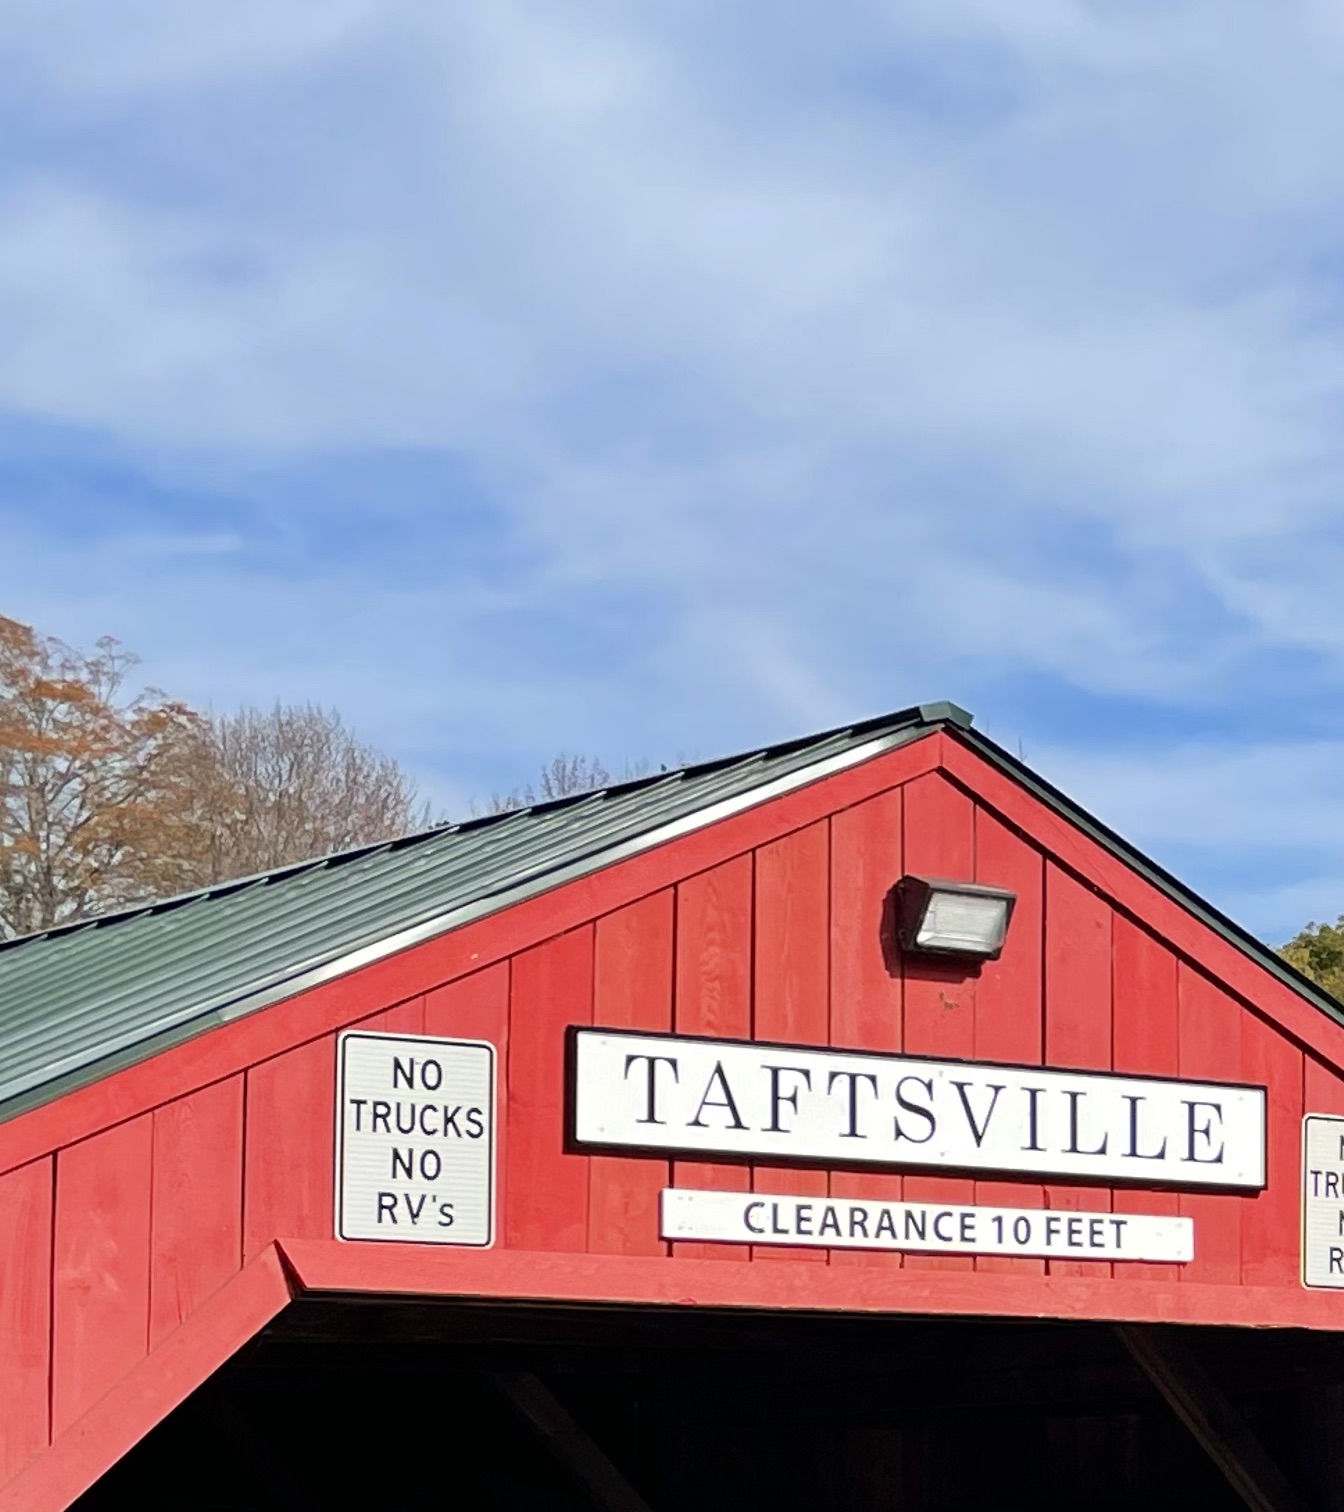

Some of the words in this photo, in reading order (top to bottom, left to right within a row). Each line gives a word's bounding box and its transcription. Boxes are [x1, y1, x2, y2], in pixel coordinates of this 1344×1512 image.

[393, 1056, 442, 1091] NO
[349, 1099, 485, 1139] TRUCKS
[623, 1053, 1225, 1165] TAFTSVILLE
[391, 1147, 442, 1181] NO
[376, 1192, 455, 1227] RV's
[743, 1201, 977, 1243] CLEARANCE
[991, 1215, 1032, 1245] 10
[1045, 1217, 1129, 1249] FEET
